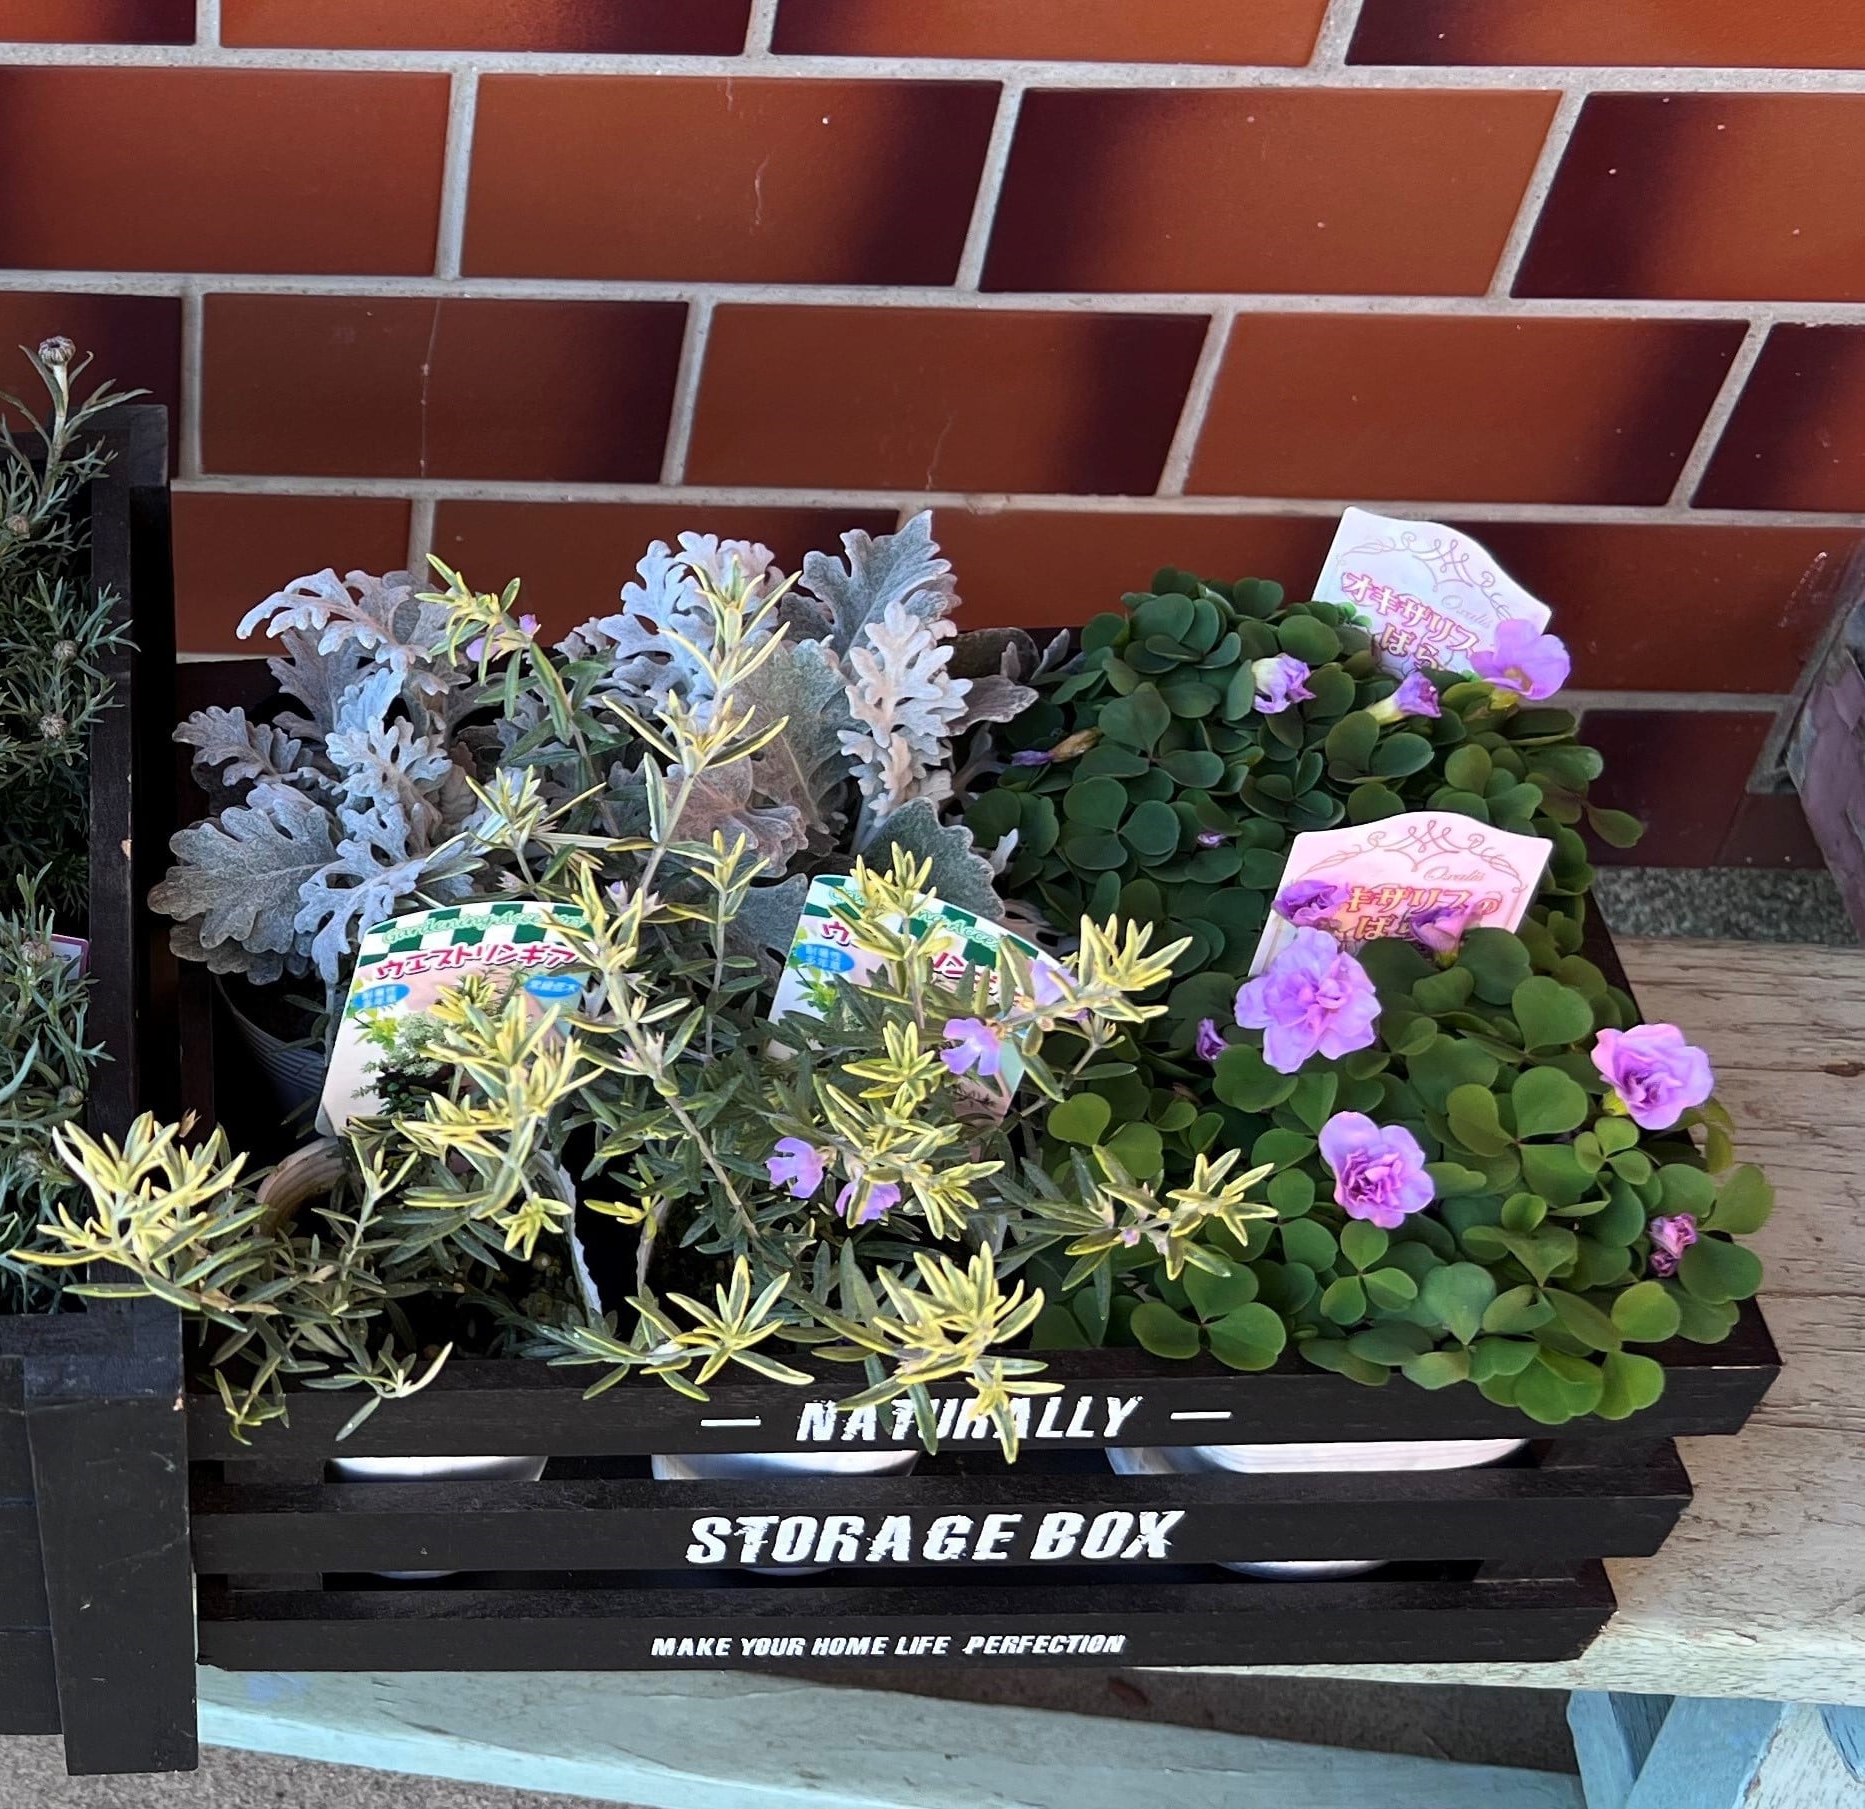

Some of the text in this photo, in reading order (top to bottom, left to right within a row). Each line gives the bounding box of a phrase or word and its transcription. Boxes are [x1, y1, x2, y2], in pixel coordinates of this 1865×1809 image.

[377, 942, 578, 979] ウエストリンギア
[796, 1395, 1143, 1441] NATURALLY
[686, 1511, 1185, 1563] STORAGE BOX
[651, 1634, 1126, 1657] MAKE YOUR HOME LIFE PERFECTION
